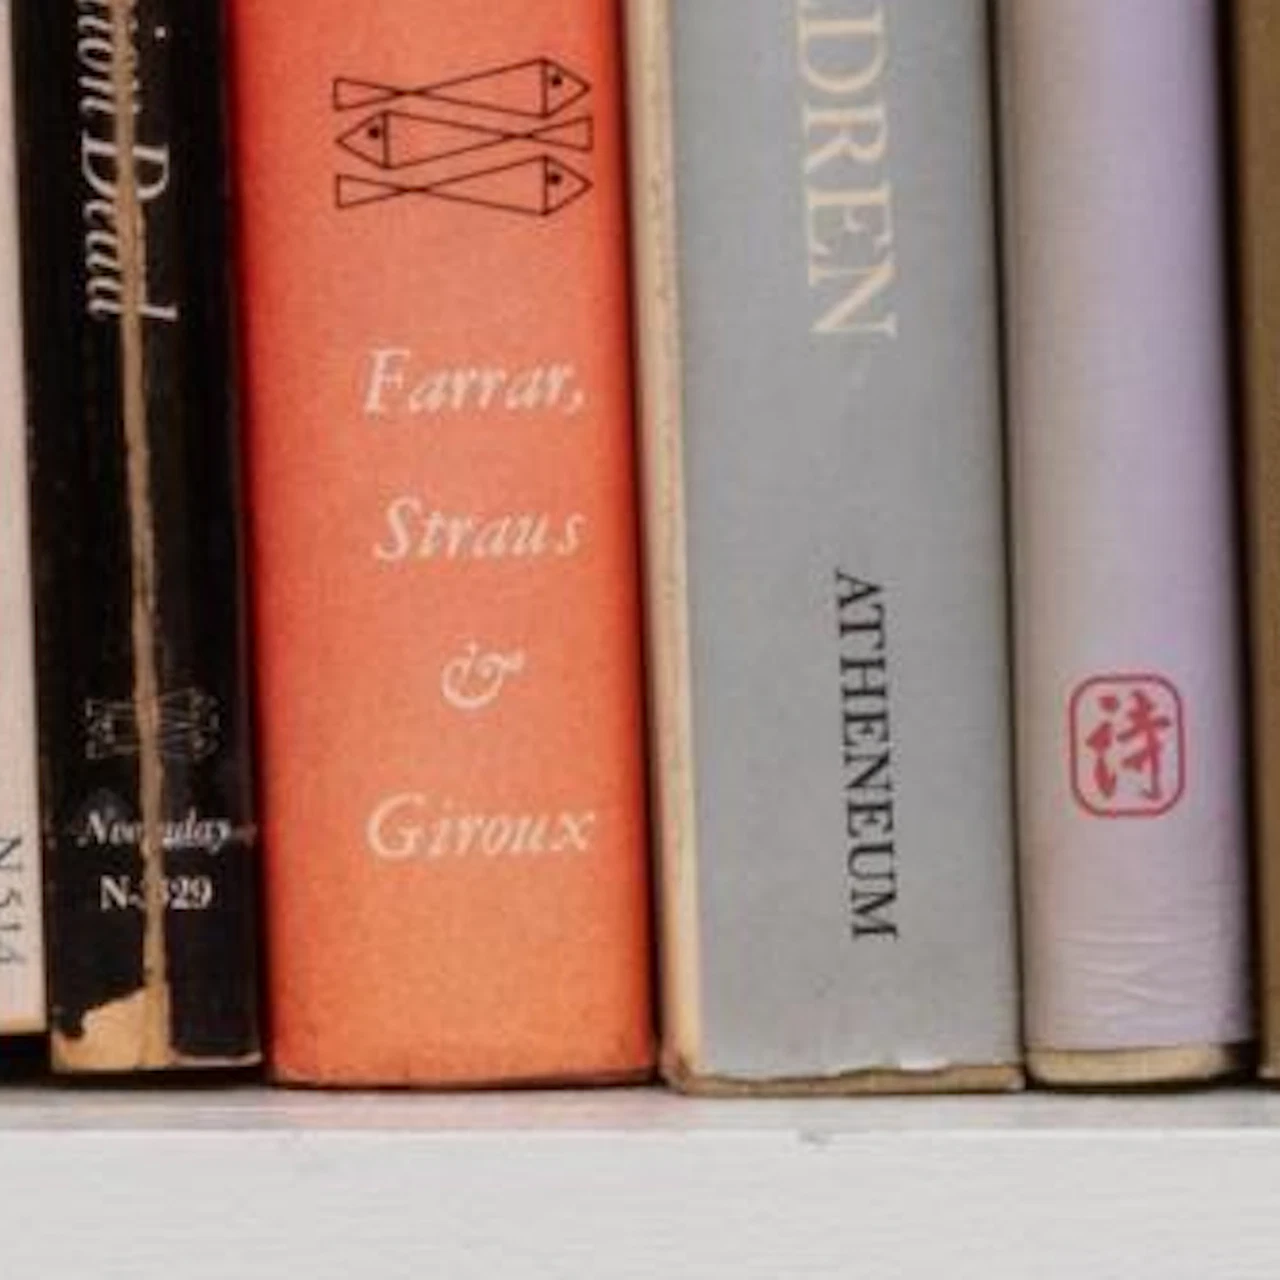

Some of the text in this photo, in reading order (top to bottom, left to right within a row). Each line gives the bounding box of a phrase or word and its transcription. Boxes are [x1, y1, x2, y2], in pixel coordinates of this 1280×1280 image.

[81, 130, 178, 323] Dead
[363, 348, 585, 416] Farrar,
[373, 496, 586, 562] Straus
[440, 641, 525, 710] &
[835, 566, 900, 943] ATHENEUM
[367, 792, 595, 861] Giroux
